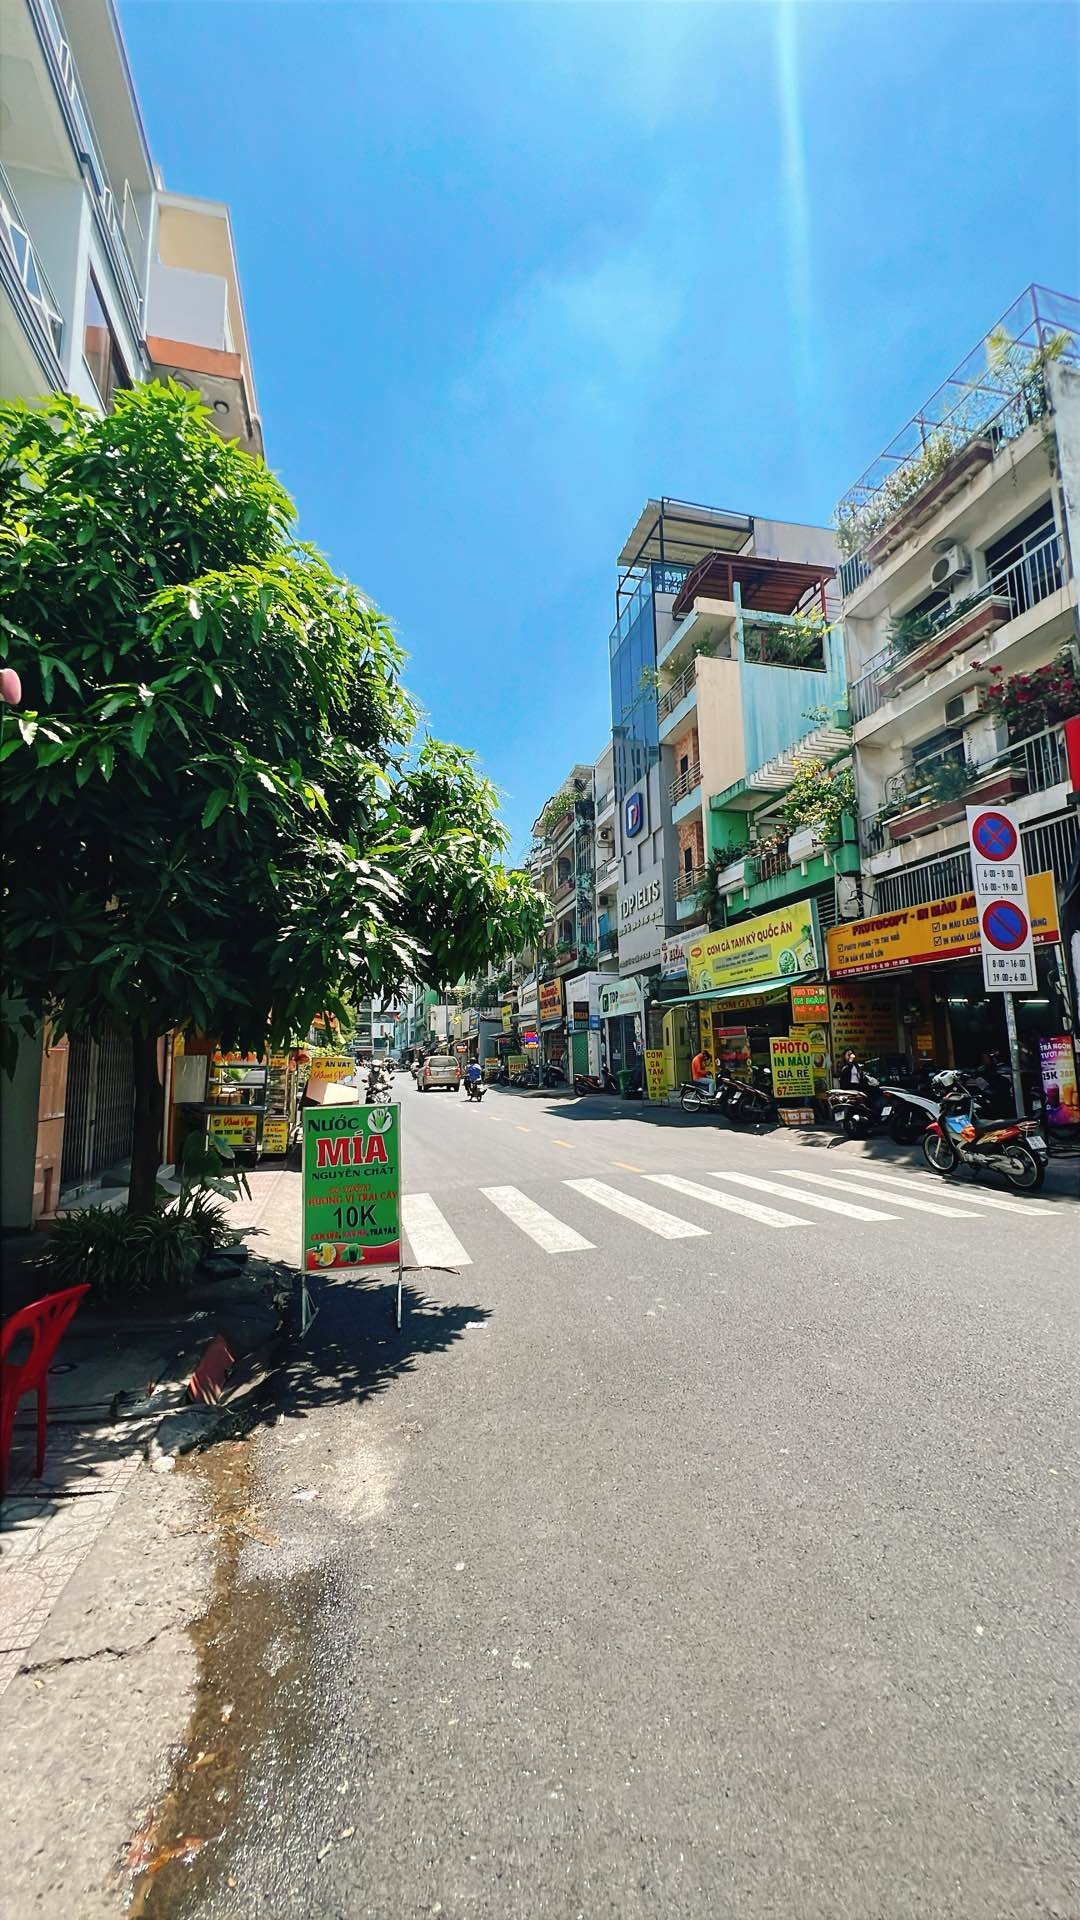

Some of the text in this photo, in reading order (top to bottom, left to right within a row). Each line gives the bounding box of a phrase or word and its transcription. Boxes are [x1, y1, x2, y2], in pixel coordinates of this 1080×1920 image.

[731, 936, 746, 949] TAM
[773, 1042, 810, 1054] PHOTO
[774, 1053, 810, 1067] IN MÀU
[308, 1114, 359, 1132] NƯỚC
[316, 1130, 389, 1168] MÍA
[312, 1164, 395, 1180] NGUYÊN CHẤT
[333, 1204, 377, 1229] 10K
